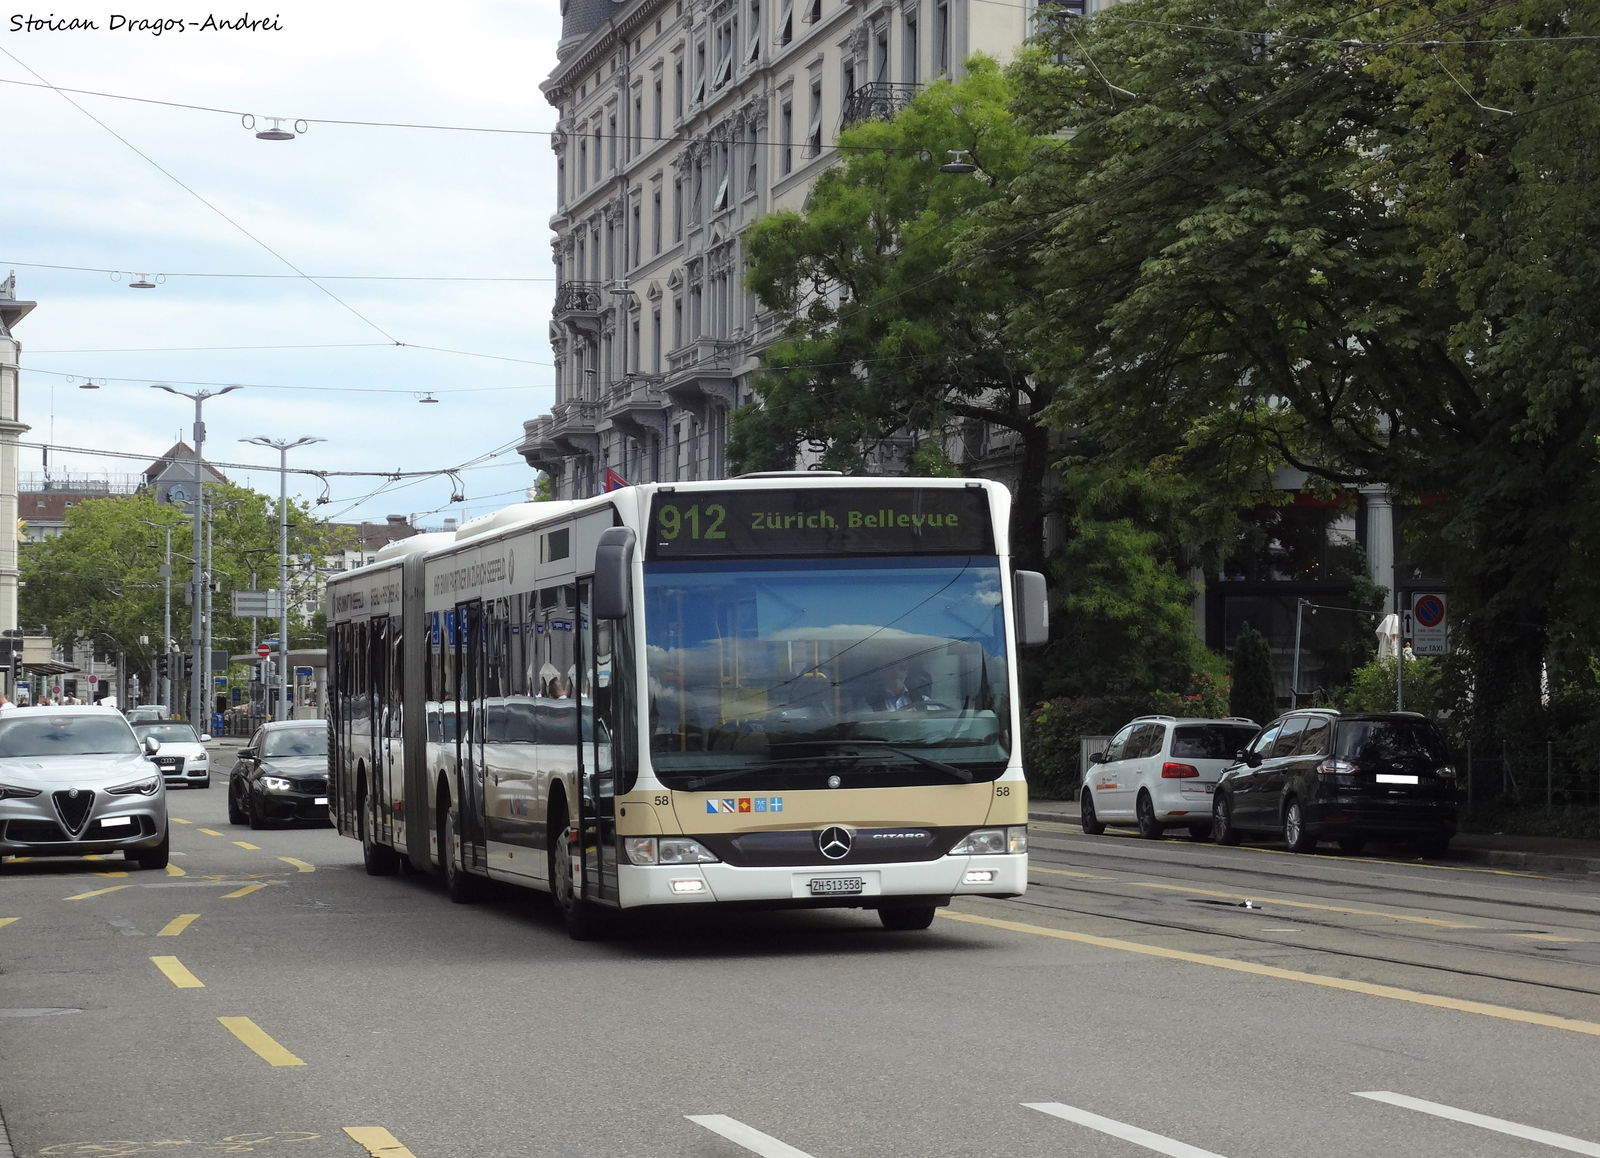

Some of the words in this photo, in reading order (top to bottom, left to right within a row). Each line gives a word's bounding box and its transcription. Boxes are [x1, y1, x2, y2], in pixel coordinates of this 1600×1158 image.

[658, 503, 727, 540] 912
[751, 510, 840, 530] Zürich,
[848, 509, 959, 528] Bellevue
[1429, 644, 1443, 652] TAXI
[996, 786, 1010, 797] 58
[654, 795, 669, 806] 58
[872, 832, 926, 840] CITARO
